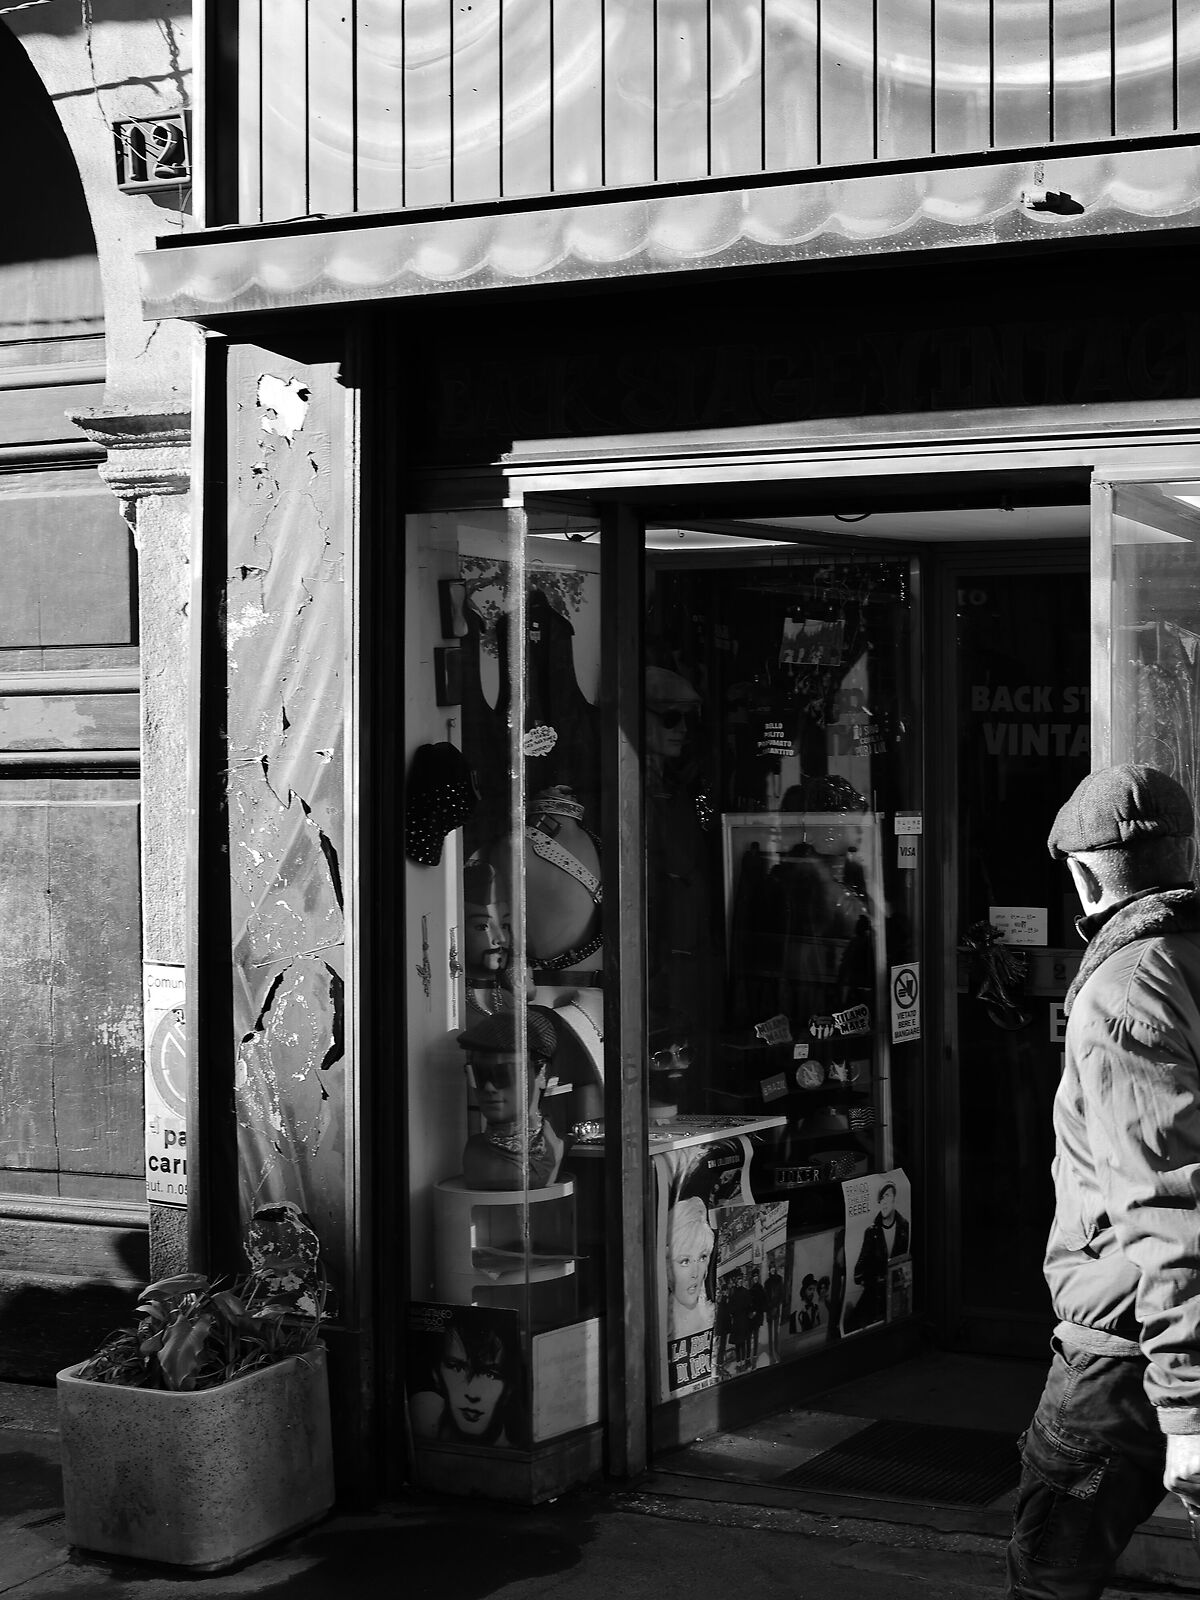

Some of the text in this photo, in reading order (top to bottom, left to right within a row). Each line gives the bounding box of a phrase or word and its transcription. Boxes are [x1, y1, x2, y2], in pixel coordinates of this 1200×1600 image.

[438, 354, 620, 438] BACK
[617, 338, 866, 428] STAGE
[971, 685, 1054, 713] BACK
[982, 721, 1091, 757] VINTA
[899, 846, 917, 857] VISA
